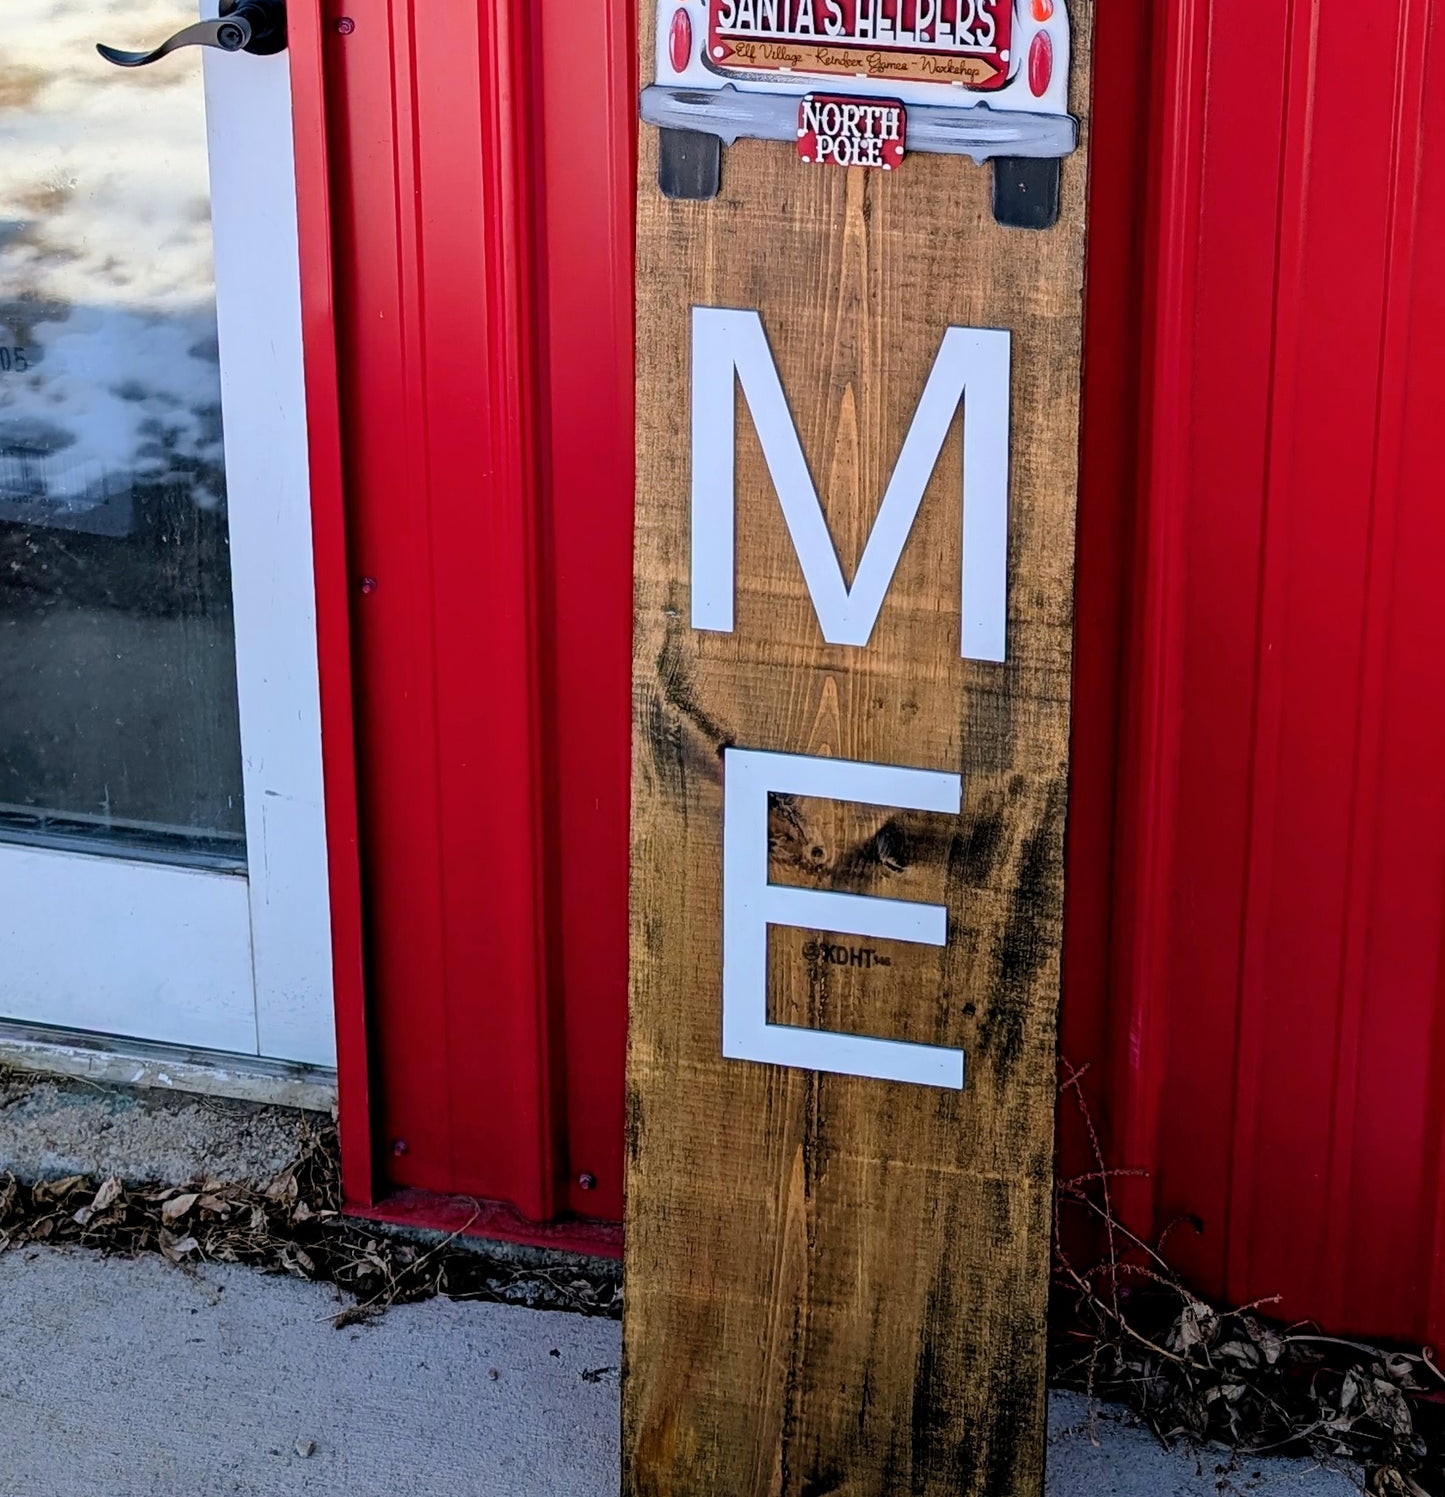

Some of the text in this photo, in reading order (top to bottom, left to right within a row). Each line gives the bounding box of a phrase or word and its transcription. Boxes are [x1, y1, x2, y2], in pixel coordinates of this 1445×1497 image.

[735, 42, 756, 63] Elf
[759, 44, 803, 66] Village
[815, 47, 863, 68] Reindeer
[866, 52, 908, 73] Games
[920, 55, 980, 82] Workshop
[801, 97, 900, 140] NORTH
[815, 134, 883, 167] POLE
